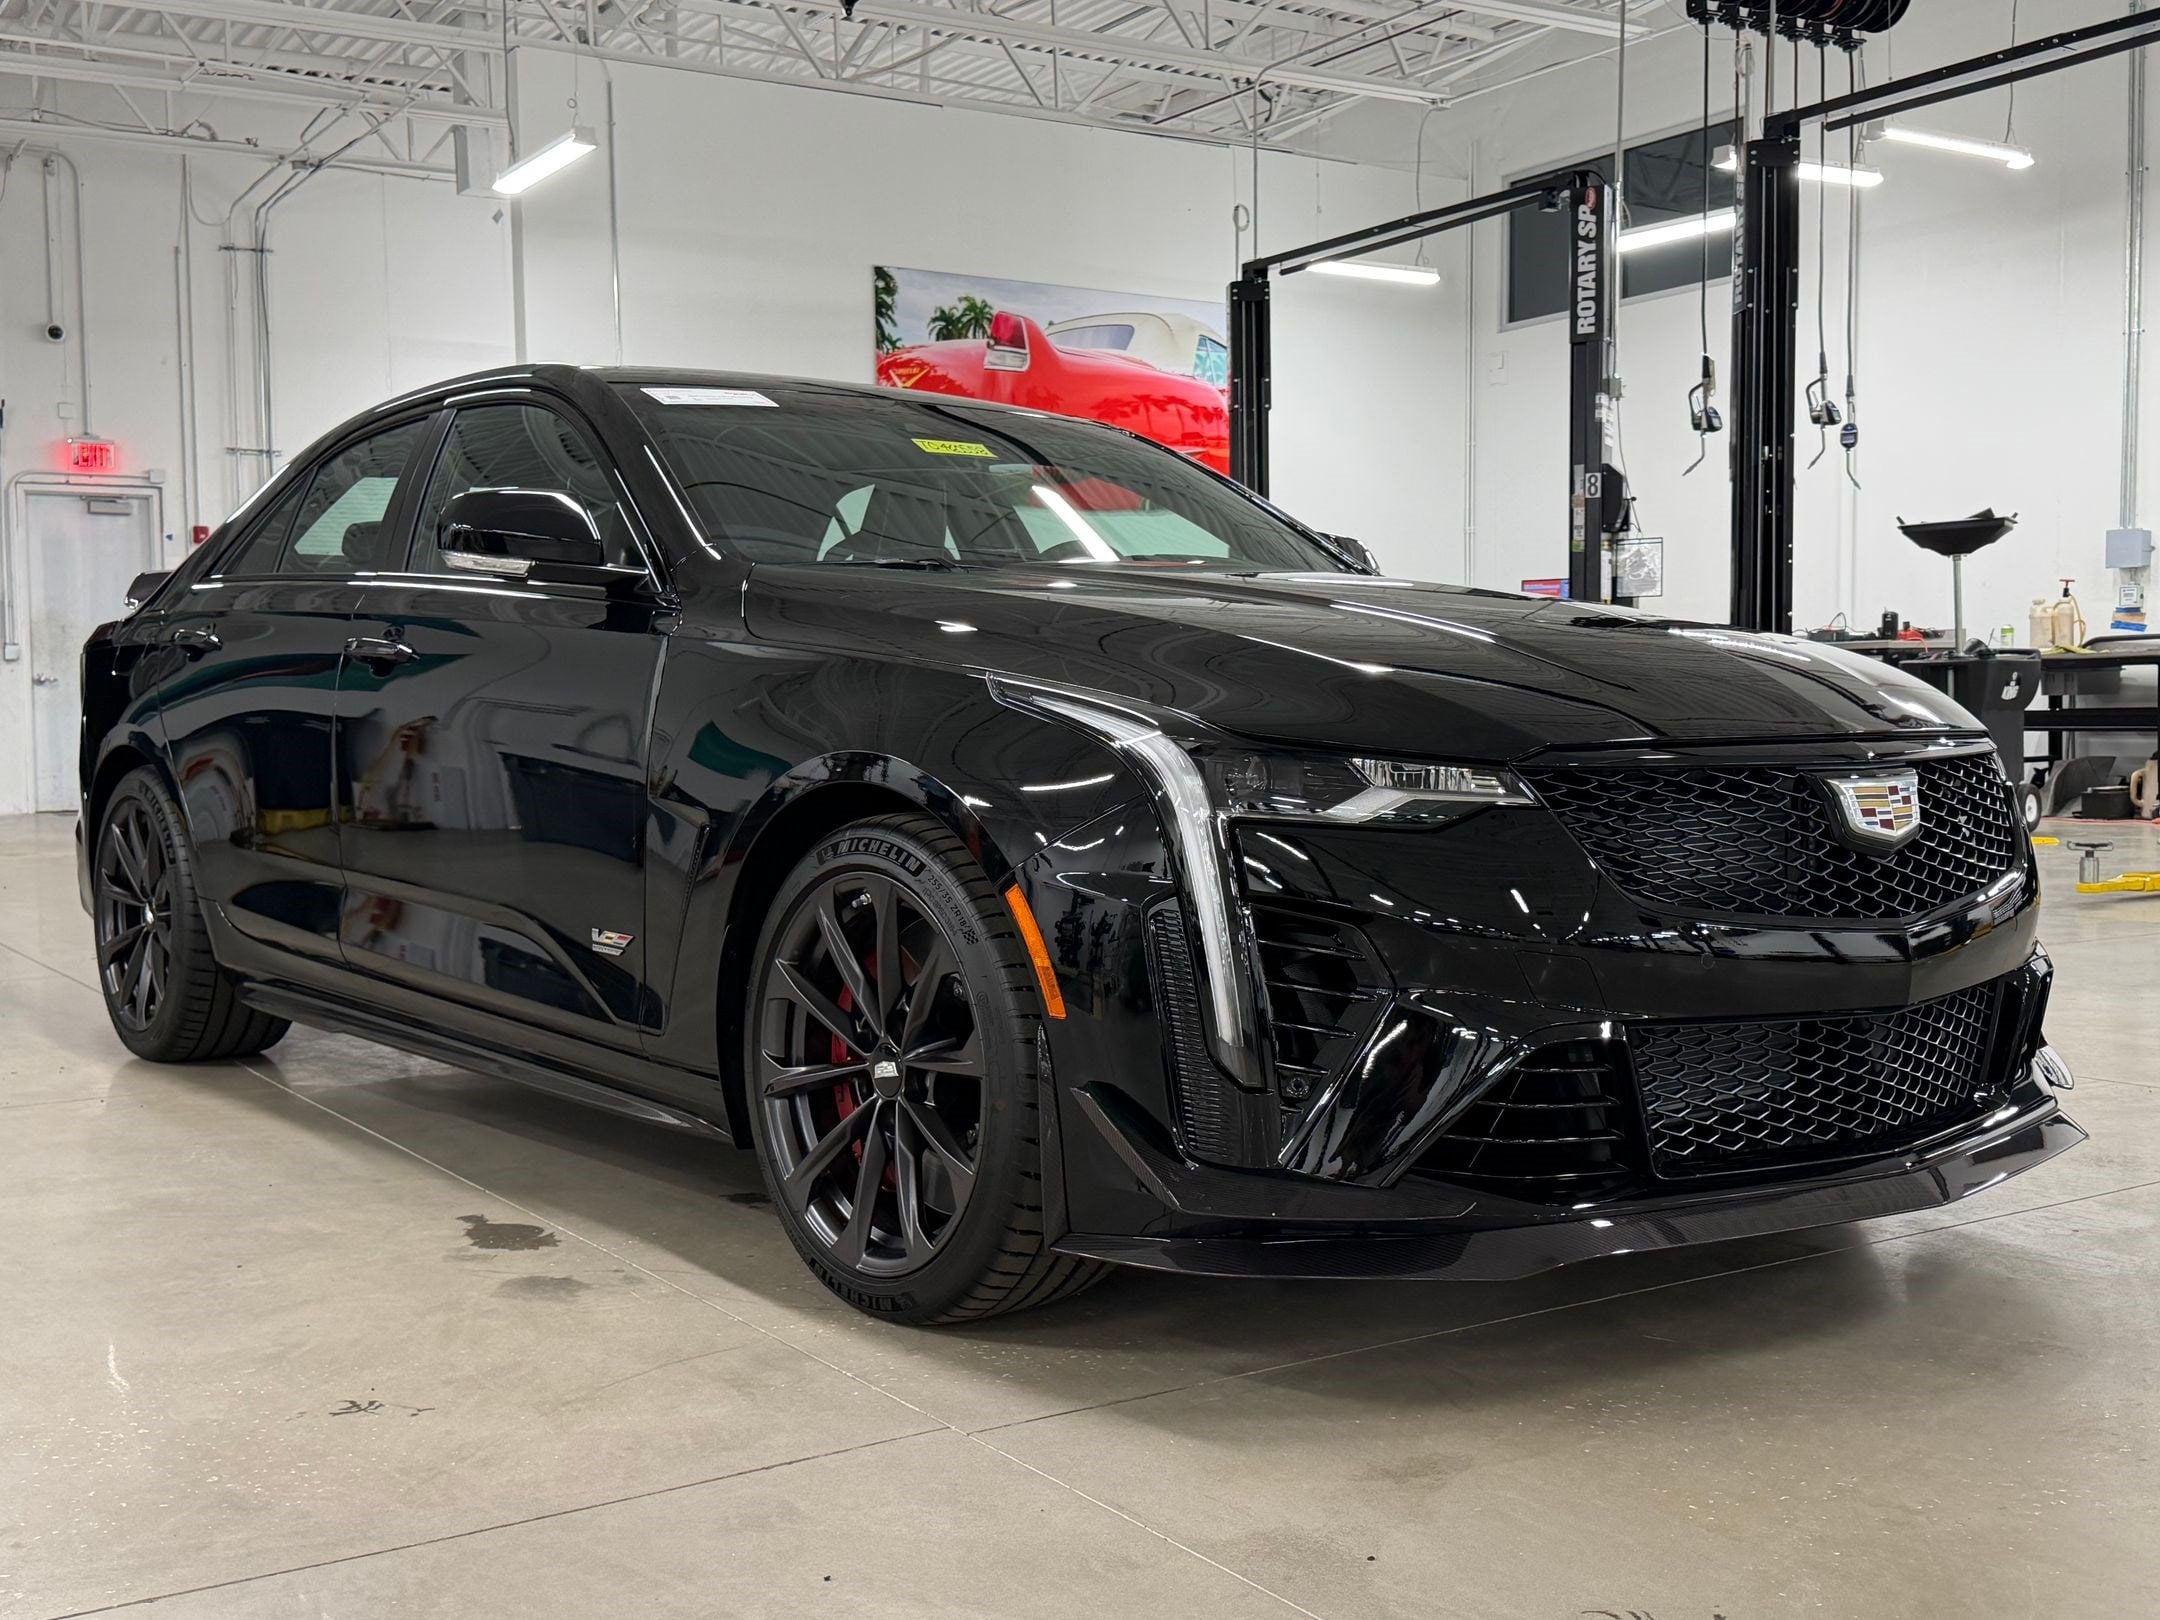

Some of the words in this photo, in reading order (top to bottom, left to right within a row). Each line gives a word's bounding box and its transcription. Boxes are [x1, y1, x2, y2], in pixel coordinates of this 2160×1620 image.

[1578, 204, 1597, 238] SP
[1577, 240, 1597, 334] ROTARY
[80, 446, 109, 467] EXIT
[1588, 474, 1598, 496] 8
[837, 838, 921, 872] MICHELIN
[927, 874, 951, 903] 255/35
